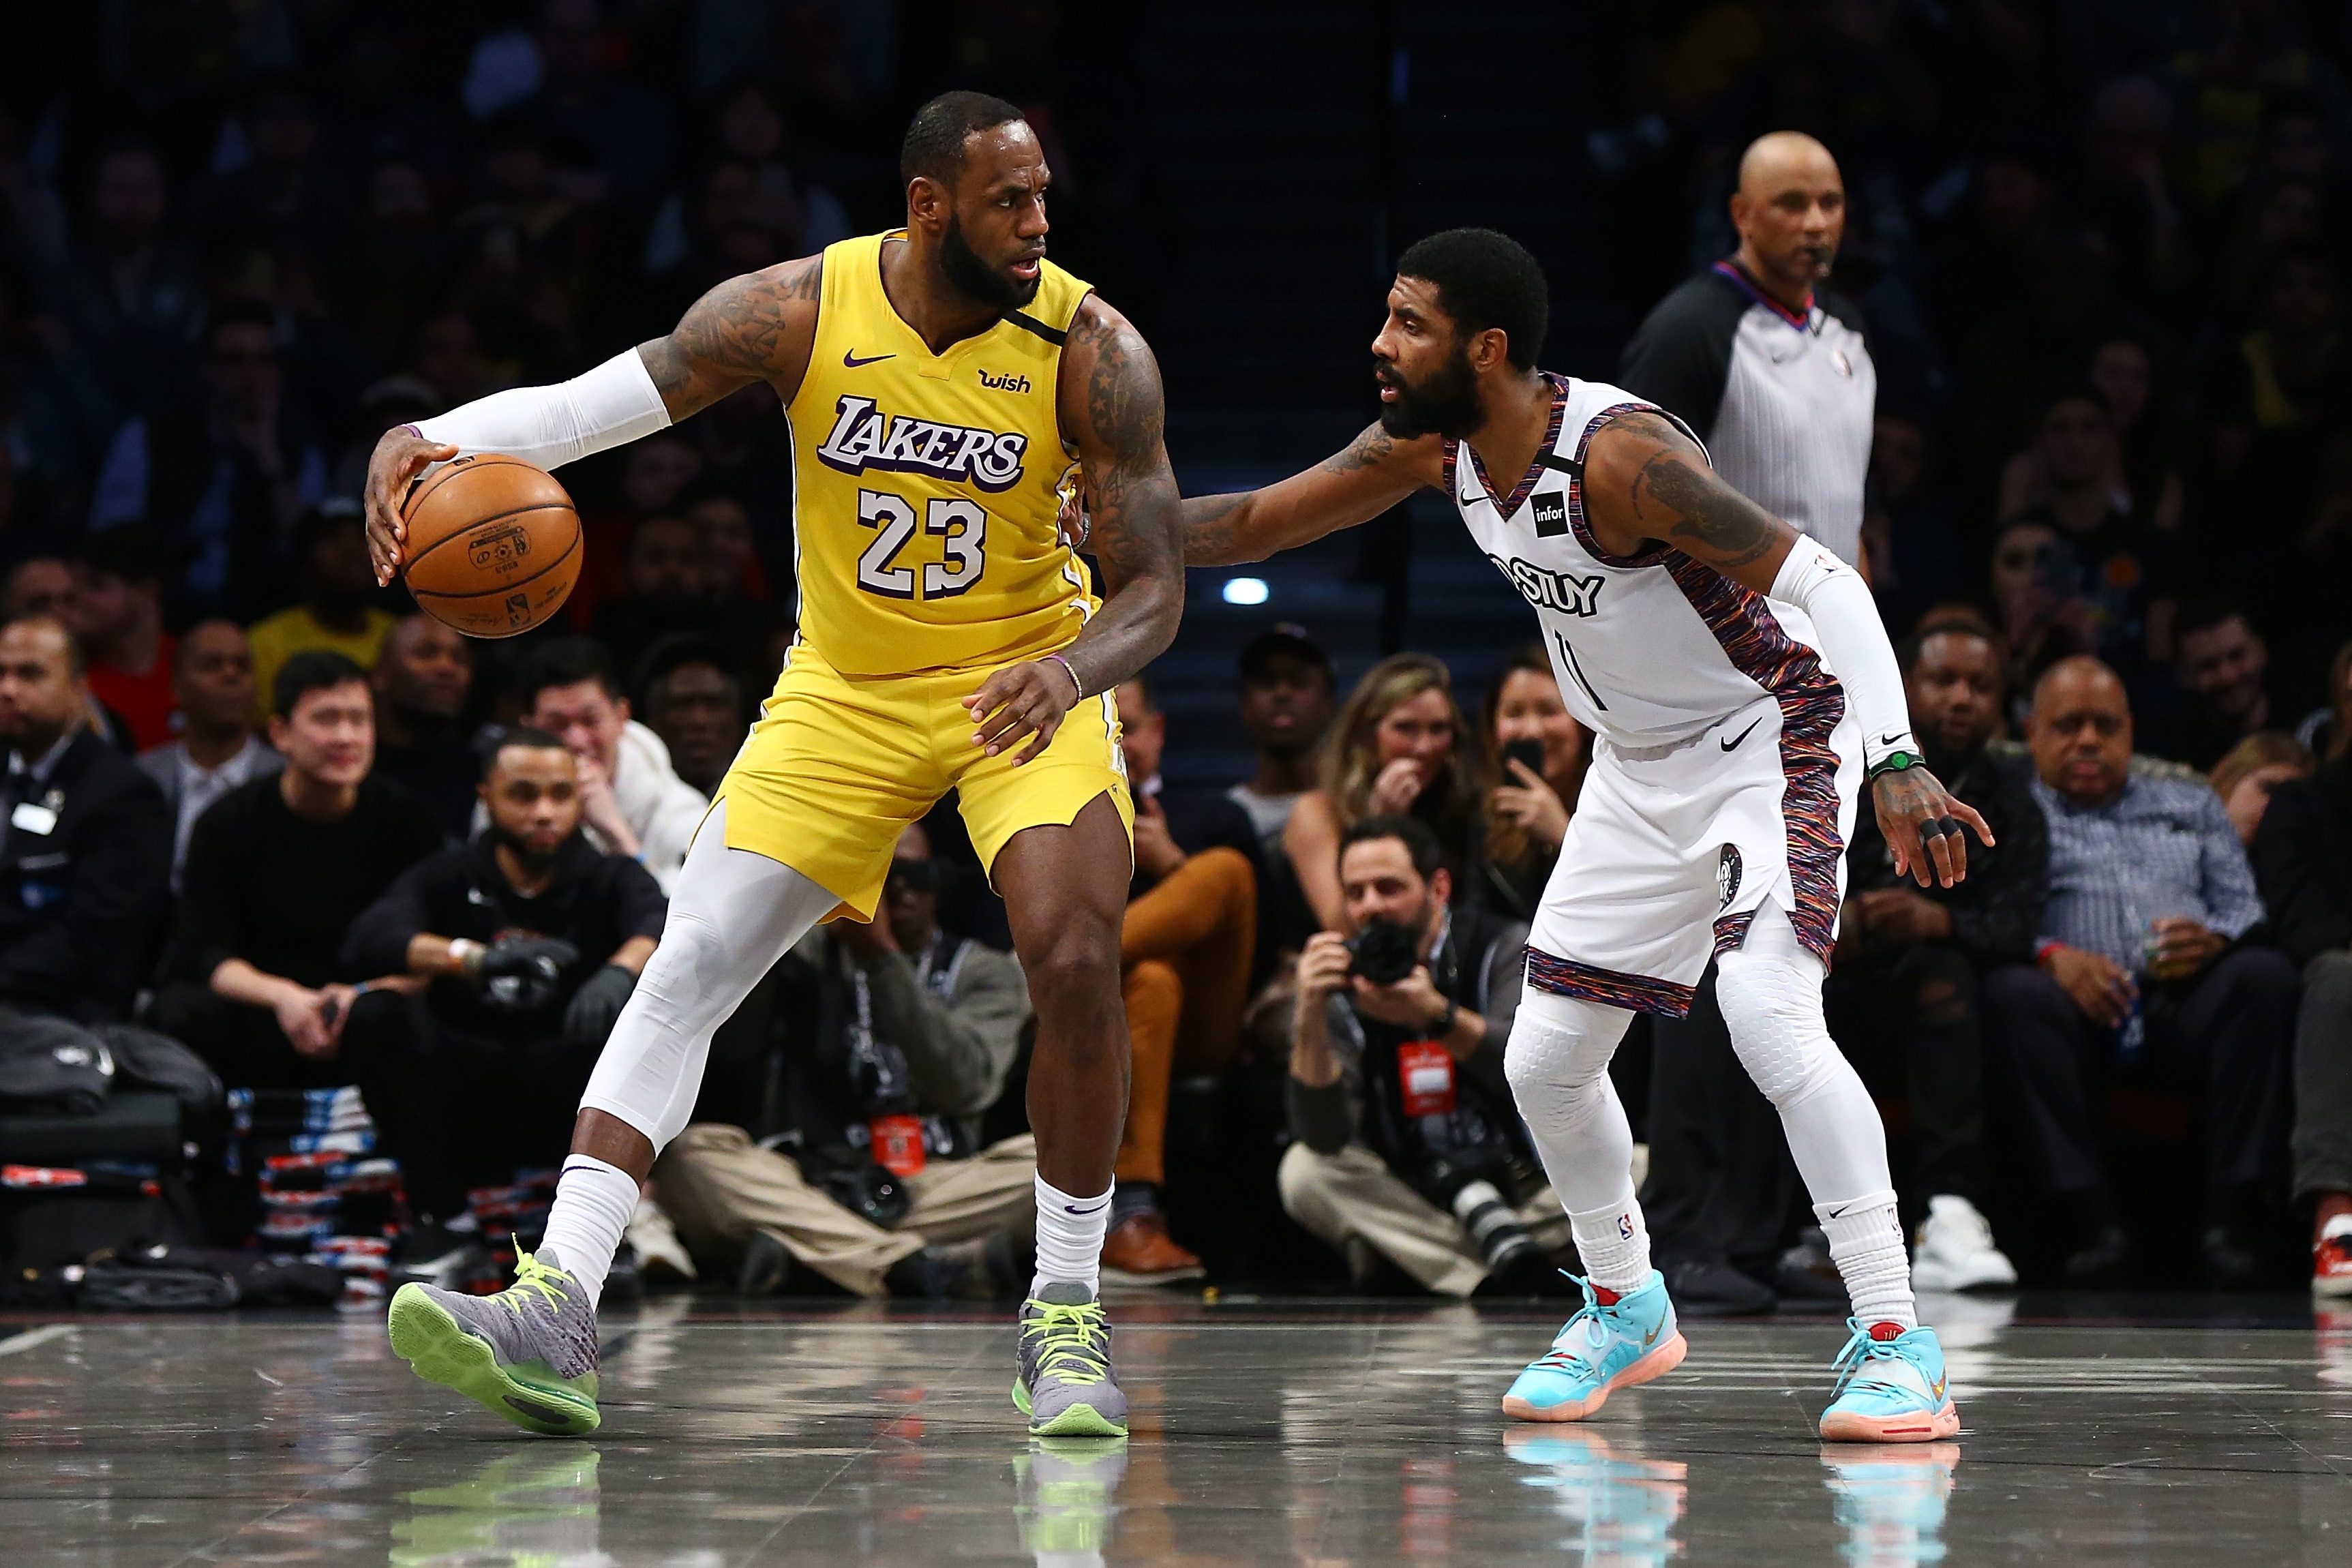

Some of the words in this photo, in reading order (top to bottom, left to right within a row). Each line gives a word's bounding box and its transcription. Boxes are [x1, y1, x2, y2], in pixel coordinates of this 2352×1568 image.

[978, 369, 1031, 393] wish
[817, 395, 1028, 494] LAKERS
[856, 487, 988, 601] 23
[1535, 505, 1563, 522] infor
